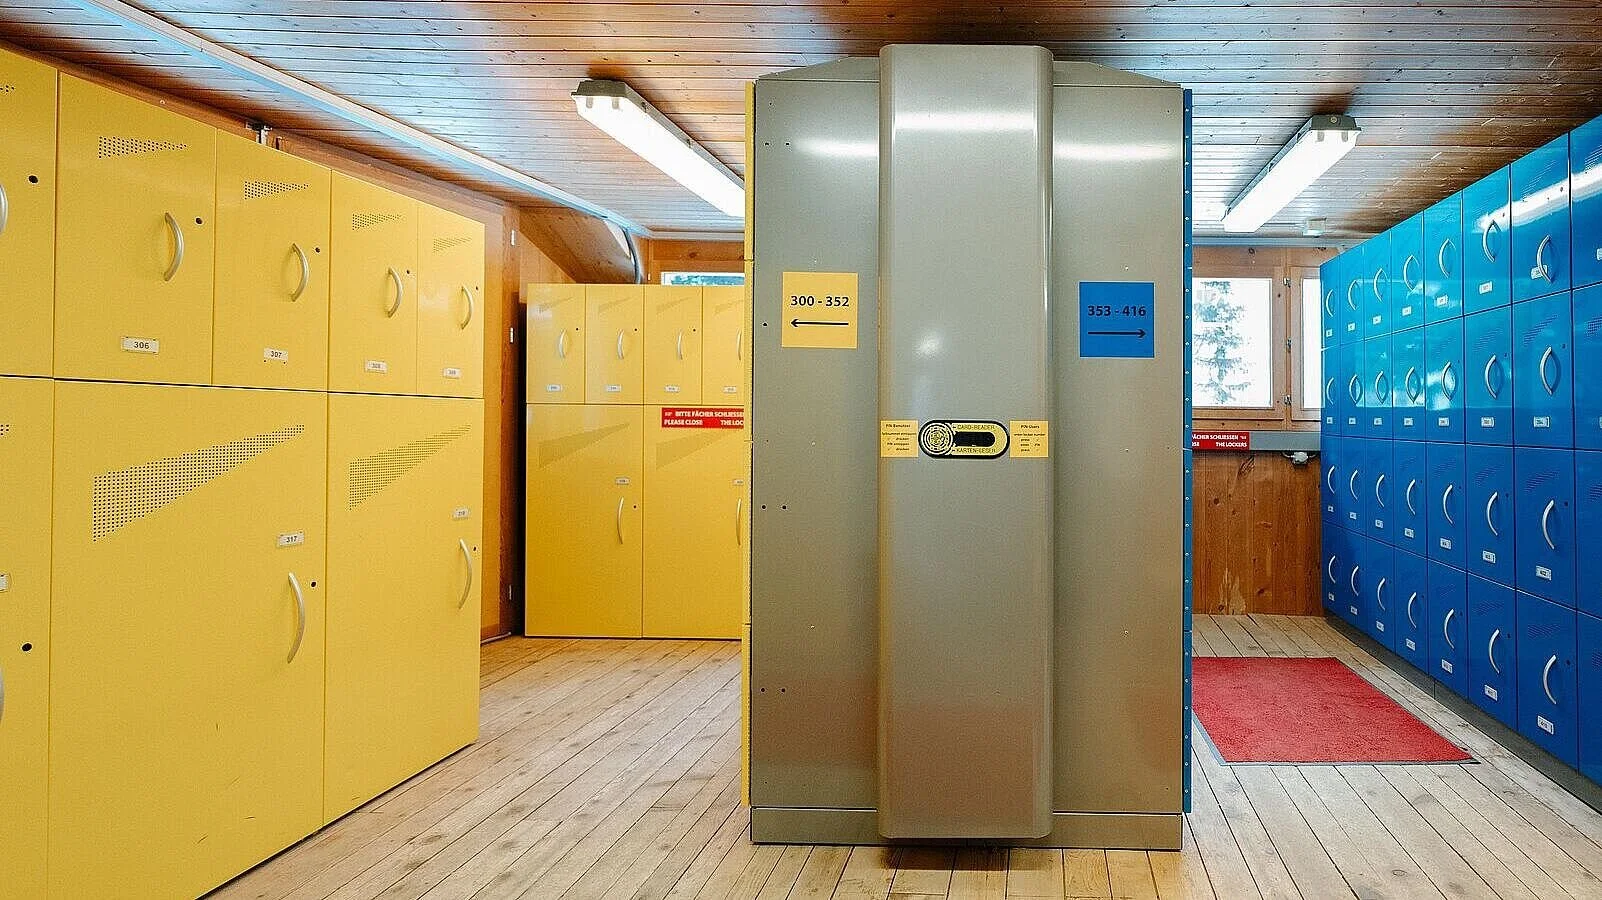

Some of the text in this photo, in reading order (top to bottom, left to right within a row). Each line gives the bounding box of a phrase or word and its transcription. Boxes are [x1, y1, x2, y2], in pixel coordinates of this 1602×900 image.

[791, 296, 815, 306] 300
[825, 296, 850, 307] 352
[1088, 306, 1112, 316] 353
[1122, 306, 1147, 316] 416
[134, 341, 150, 350] 306
